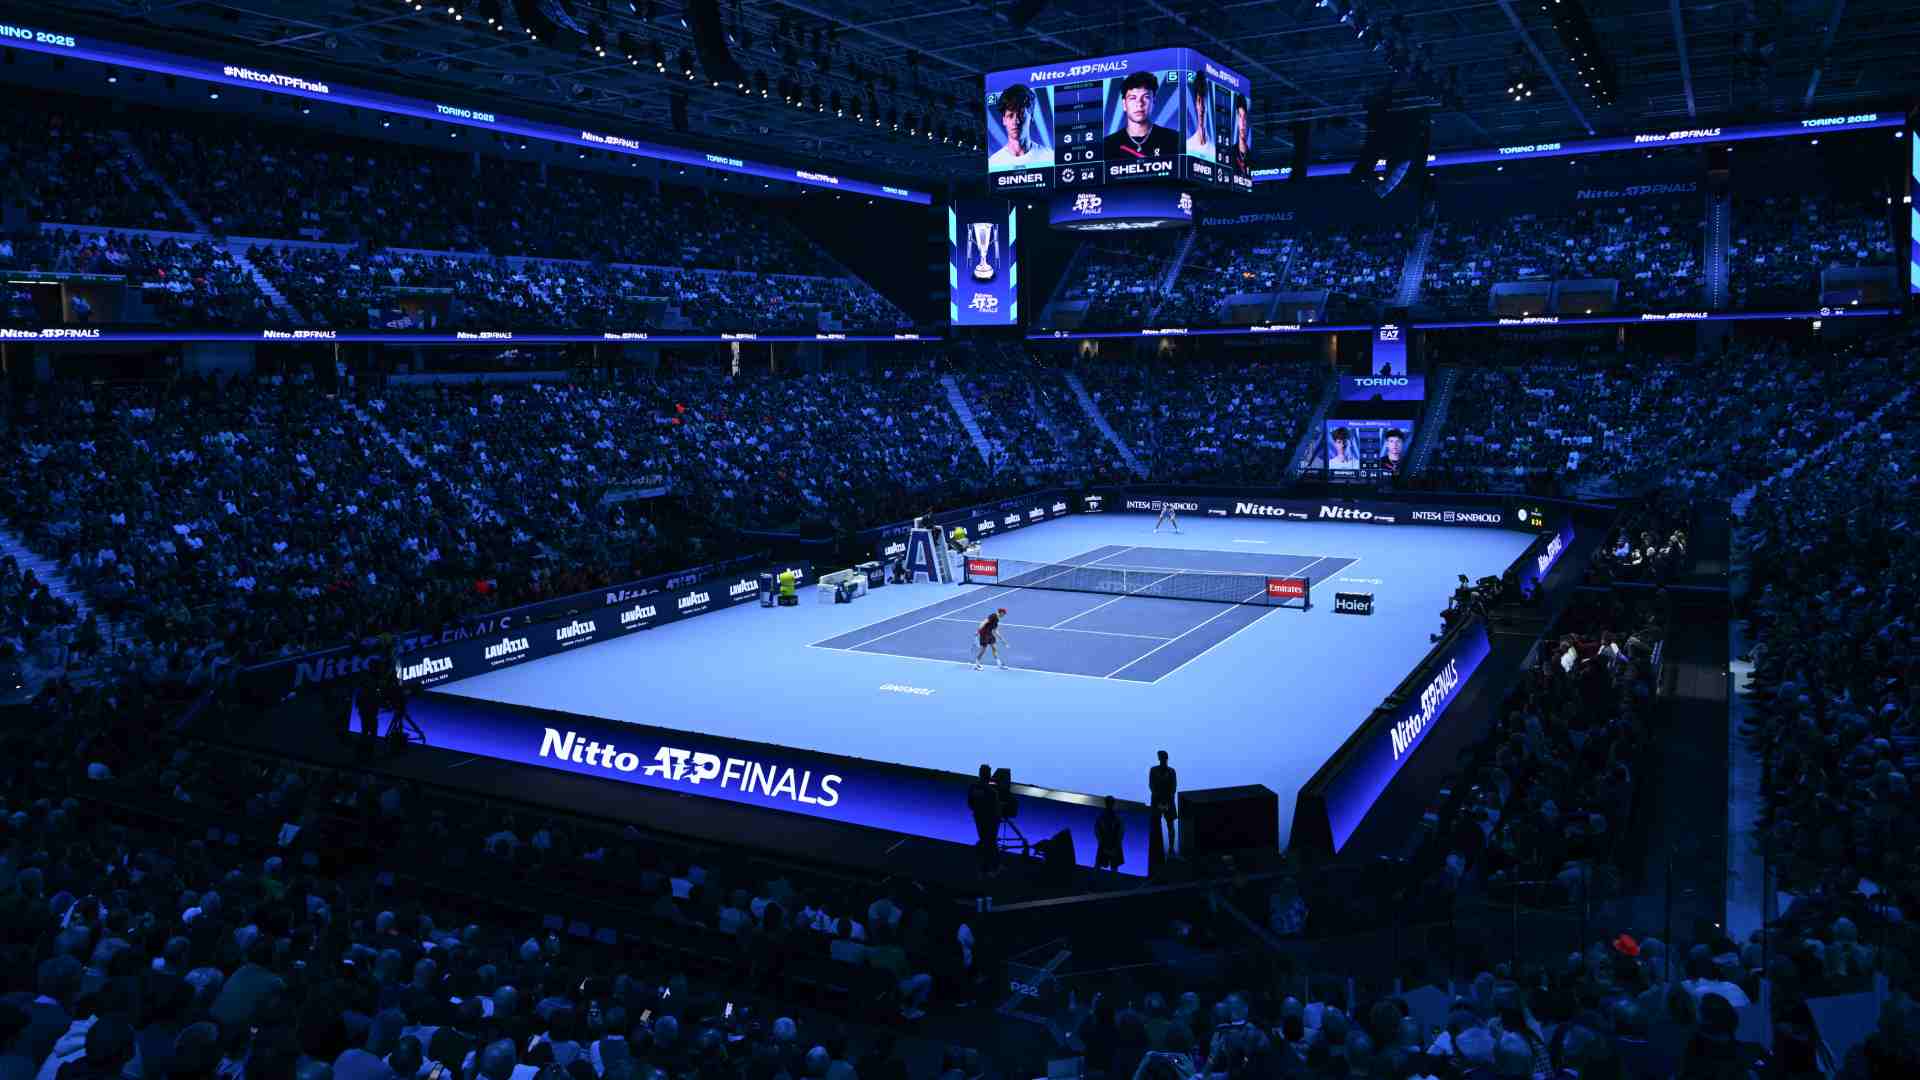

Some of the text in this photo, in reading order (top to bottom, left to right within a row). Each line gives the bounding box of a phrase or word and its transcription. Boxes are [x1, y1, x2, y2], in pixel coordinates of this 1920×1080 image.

[37, 32, 76, 47] 2025
[1030, 60, 1128, 82] Nitto ATP FINALS
[1168, 72, 1178, 81] 5
[224, 66, 329, 93] #NittoATPFinals
[436, 104, 471, 118] TORINO
[1801, 113, 1877, 127] TORINO 2025
[1063, 132, 1094, 143] 3 2
[1634, 135, 1665, 143] Nitto
[1688, 128, 1721, 137] FINALS
[1064, 150, 1094, 161] 0 0
[1499, 146, 1535, 154] TORINO
[1109, 160, 1173, 176] SHELTON
[998, 173, 1043, 185] SINNER
[1081, 172, 1094, 180] 24
[1073, 196, 1103, 211] ATP
[0, 328, 38, 338] Nitto
[64, 328, 100, 338] FINALS
[264, 330, 291, 338] Nitto
[1380, 330, 1399, 338] EA7
[1354, 377, 1408, 386] TORINO
[1126, 501, 1151, 510] INTESA
[1234, 502, 1285, 516] Nitto
[1319, 505, 1373, 519] Nitto
[1412, 511, 1501, 523] INTESA SANPAOLO
[729, 579, 759, 596] LAVAZZA
[1269, 583, 1304, 593] Emirates
[678, 591, 710, 609] LAVAZZA
[1336, 599, 1370, 611] Haier
[621, 604, 657, 624] LAVAZZA
[556, 620, 596, 640] LAVAZZA
[484, 637, 530, 660] LAVAZZA
[403, 656, 454, 681] LAVAZZA
[1390, 658, 1458, 761] Nitto ATP FINALS
[539, 727, 843, 807] Nitto ATP FINALS
[1010, 981, 1040, 997] P22
